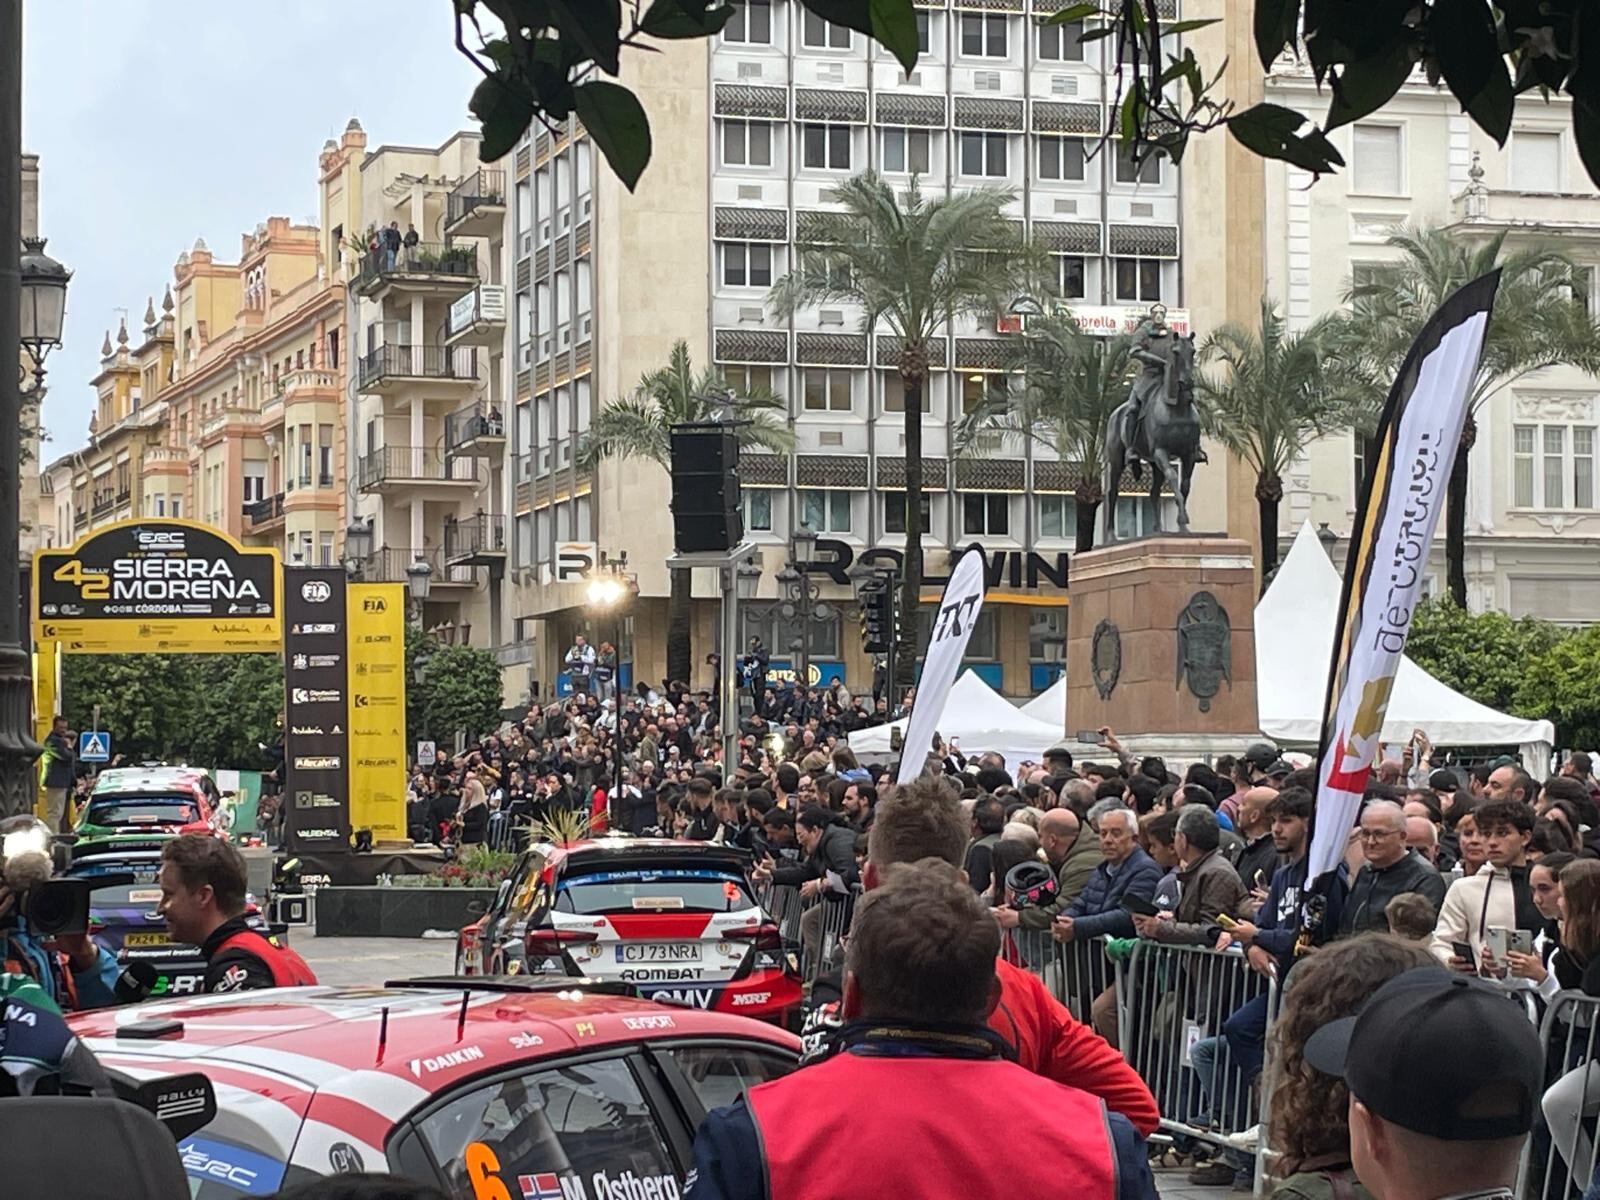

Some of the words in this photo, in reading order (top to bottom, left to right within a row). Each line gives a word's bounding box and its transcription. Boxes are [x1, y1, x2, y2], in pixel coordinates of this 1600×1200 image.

[113, 559, 234, 578] SIERRA
[113, 580, 261, 599] MORENA
[302, 585, 329, 598] FIA
[363, 600, 385, 611] FIA
[128, 934, 155, 945] PX24
[620, 968, 704, 981] ROMBAT
[732, 992, 771, 1005] MRF
[422, 1045, 484, 1072] DAIKIN
[465, 1141, 512, 1200] 6
[593, 1169, 681, 1200] Østberg
